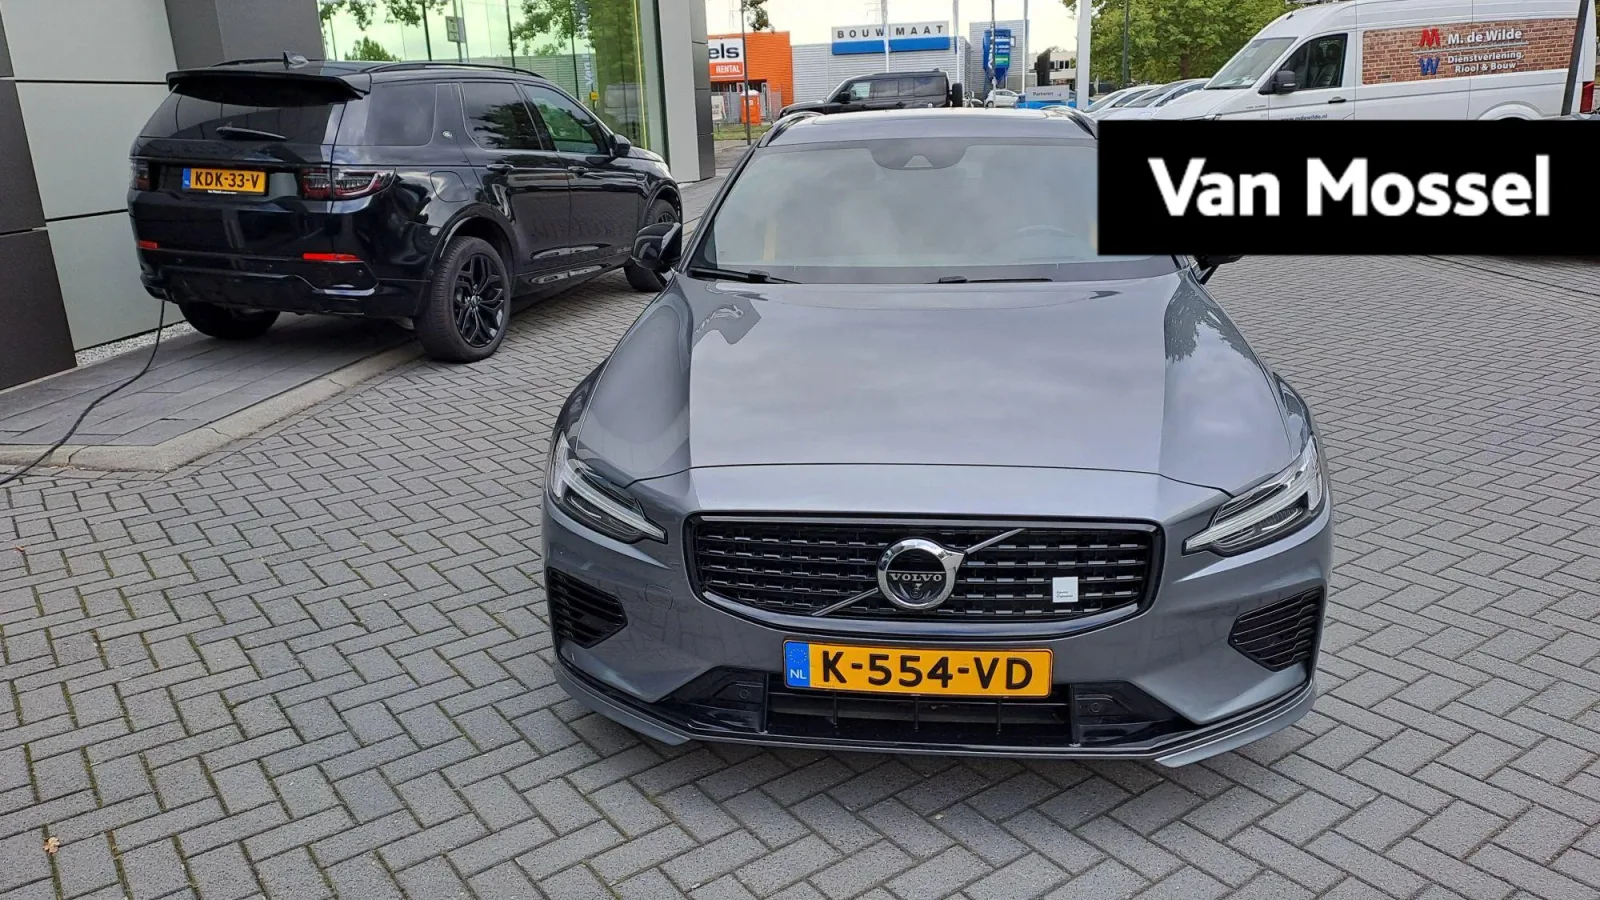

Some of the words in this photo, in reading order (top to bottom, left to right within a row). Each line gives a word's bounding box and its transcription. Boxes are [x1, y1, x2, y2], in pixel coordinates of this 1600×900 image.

[1419, 28, 1440, 47] M
[1448, 34, 1464, 45] M.
[1467, 32, 1483, 43] de
[1486, 28, 1523, 41] Wilde
[716, 65, 740, 73] RENTAL
[1418, 57, 1440, 76] W
[1455, 64, 1479, 73] Riool
[1482, 63, 1489, 71] &
[1490, 61, 1517, 71] Bouw
[195, 171, 260, 189] KDK-33-V
[889, 573, 942, 582] VOLVO
[790, 669, 807, 680] NL
[822, 650, 1033, 690] K-554-VD
